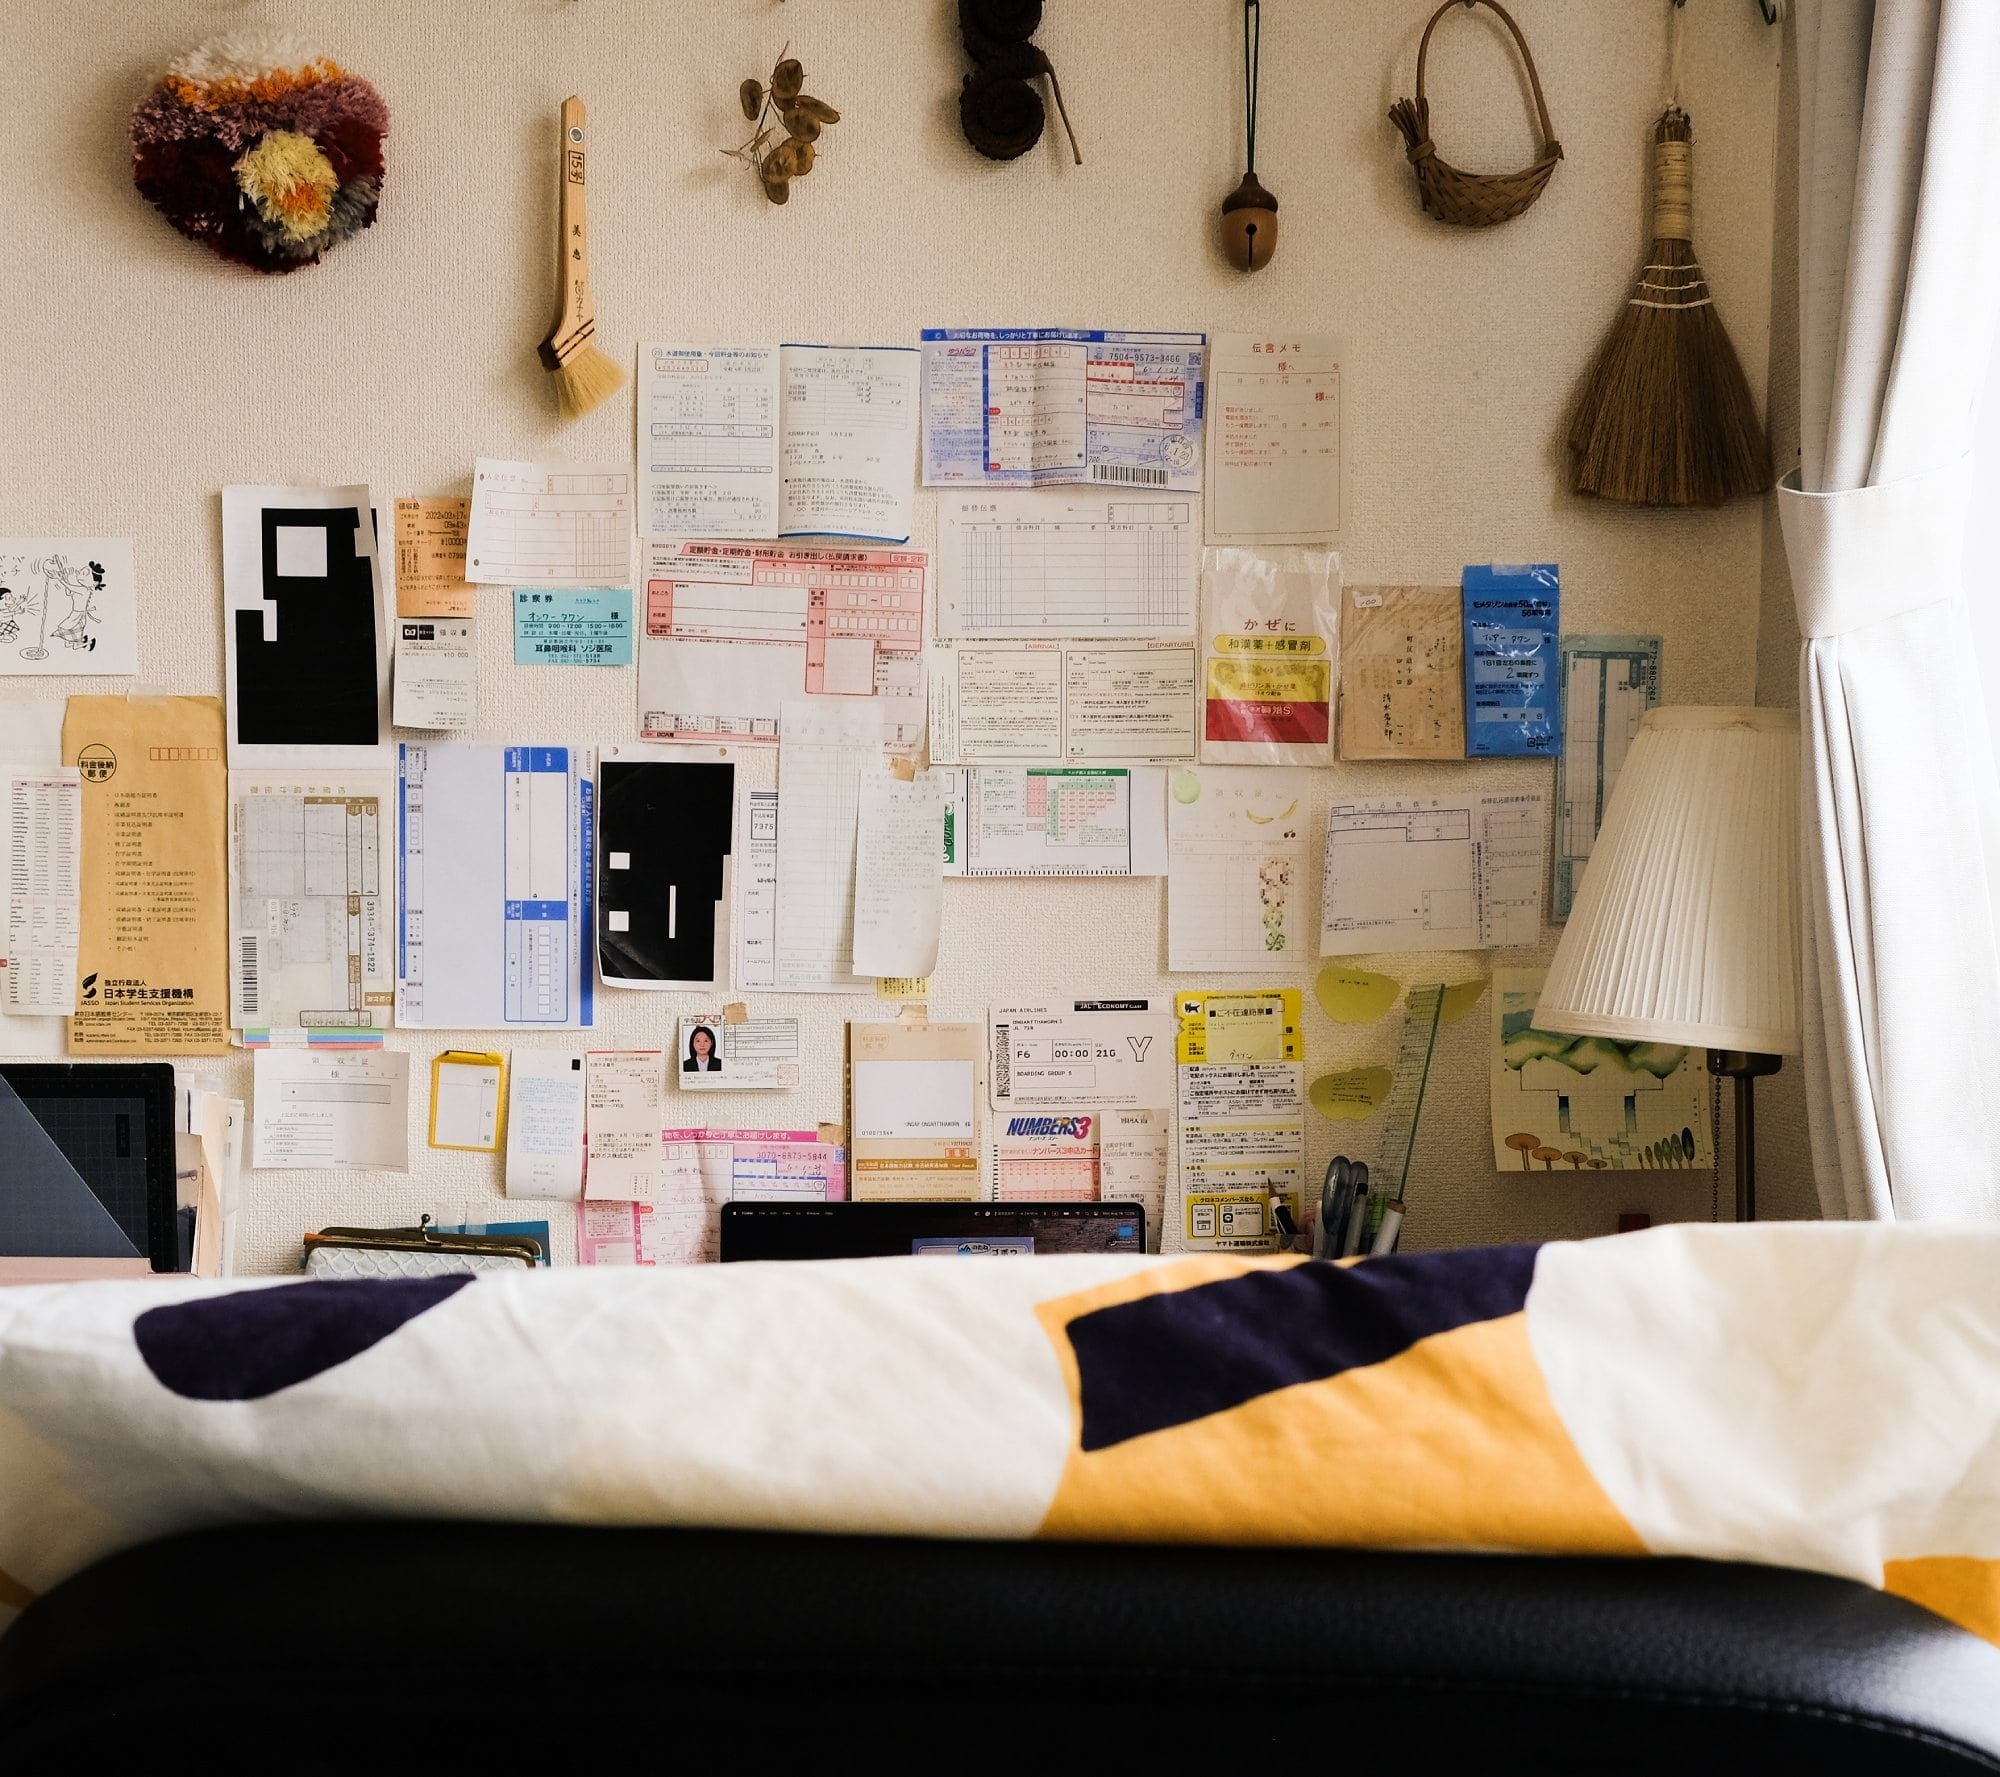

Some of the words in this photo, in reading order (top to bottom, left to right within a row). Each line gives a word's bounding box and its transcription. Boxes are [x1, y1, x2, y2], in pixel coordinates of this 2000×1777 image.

[1252, 343, 1301, 353] 伝言メモ
[519, 594, 553, 603] 診察券
[611, 612, 619, 620] 様
[1244, 618, 1296, 631] かぜに
[1506, 667, 1514, 679] 2
[80, 760, 114, 769] 料金後納
[87, 770, 108, 778] 郵便
[104, 989, 194, 999] 日本学生支援機構
[1217, 1008, 1266, 1018] ご不在連絡票
[1016, 1050, 1031, 1059] F6
[1054, 1050, 1089, 1058] 00:00
[1096, 1049, 1116, 1057] 21G
[1126, 1036, 1153, 1063] Y
[482, 1078, 496, 1086] 学校
